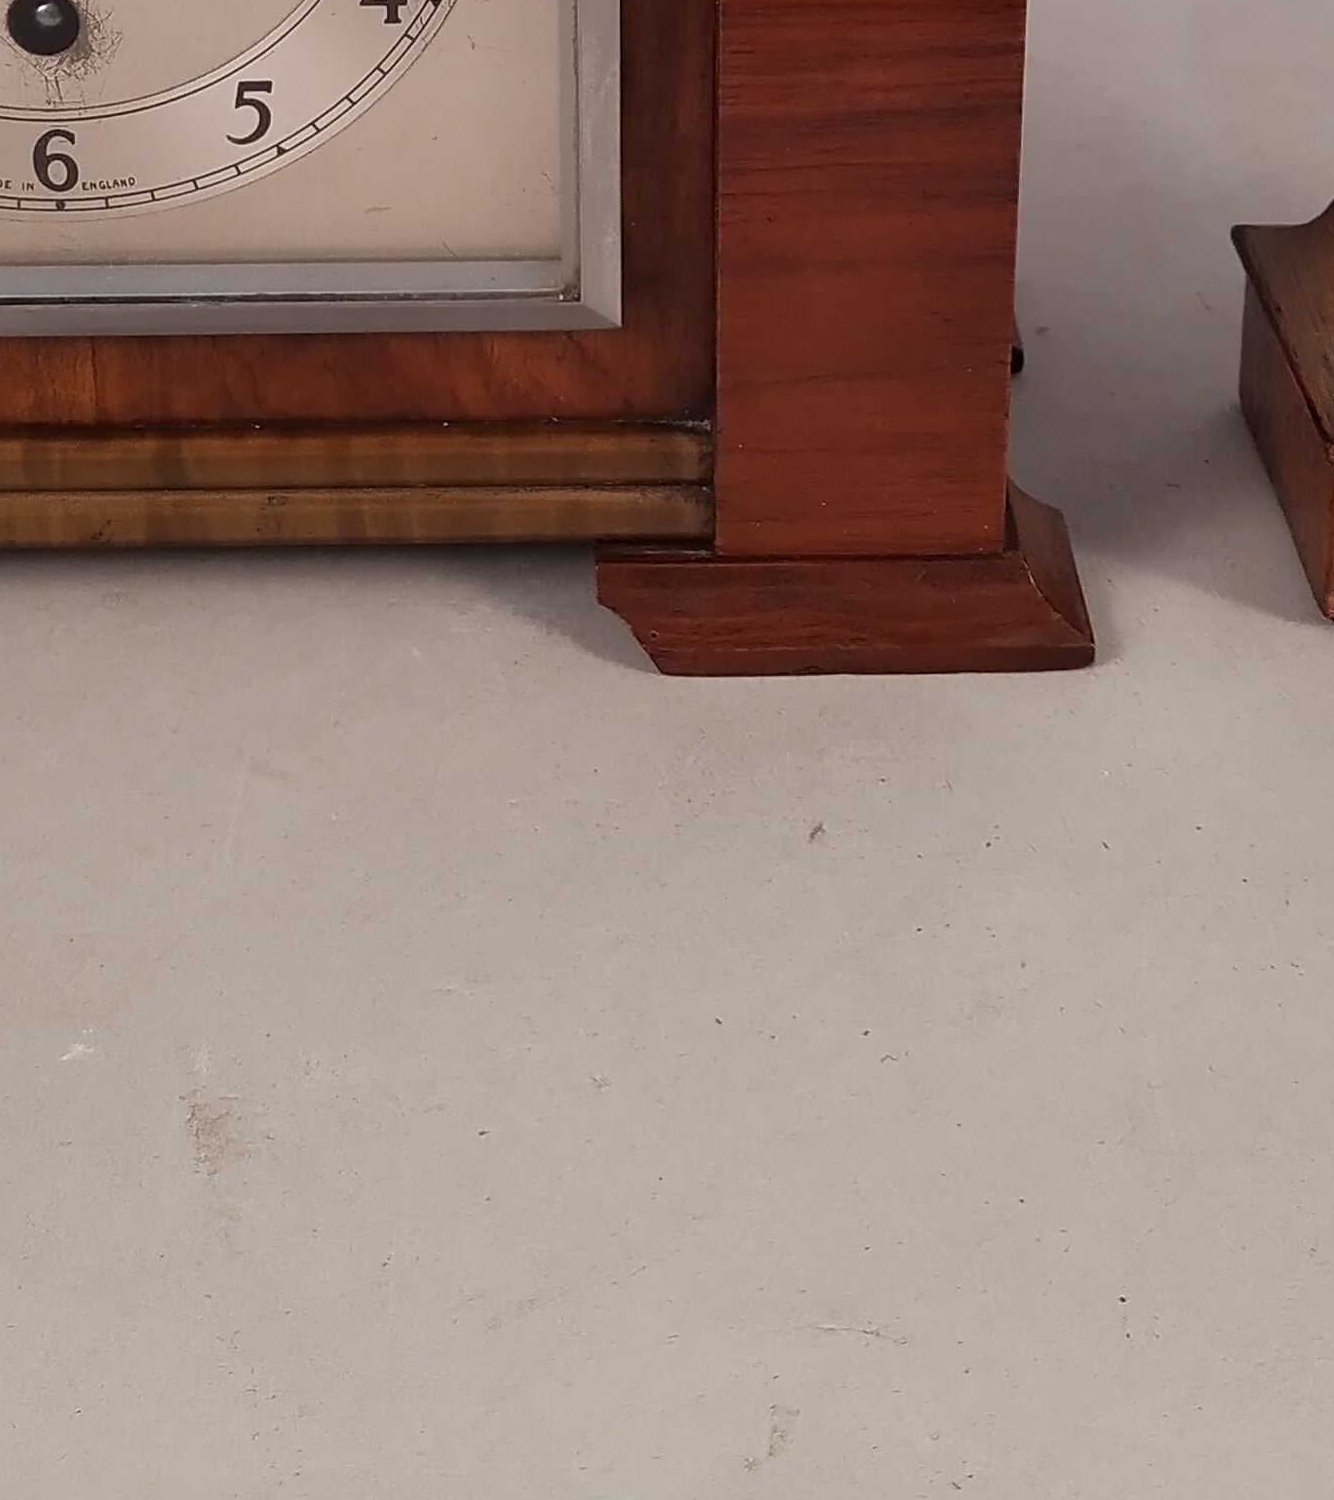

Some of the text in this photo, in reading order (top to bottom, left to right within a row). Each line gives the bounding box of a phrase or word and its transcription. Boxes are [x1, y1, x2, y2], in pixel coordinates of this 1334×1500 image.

[226, 81, 273, 145] 5
[22, 182, 35, 191] IN
[82, 176, 136, 191] ENGLAND
[33, 129, 79, 192] 6
